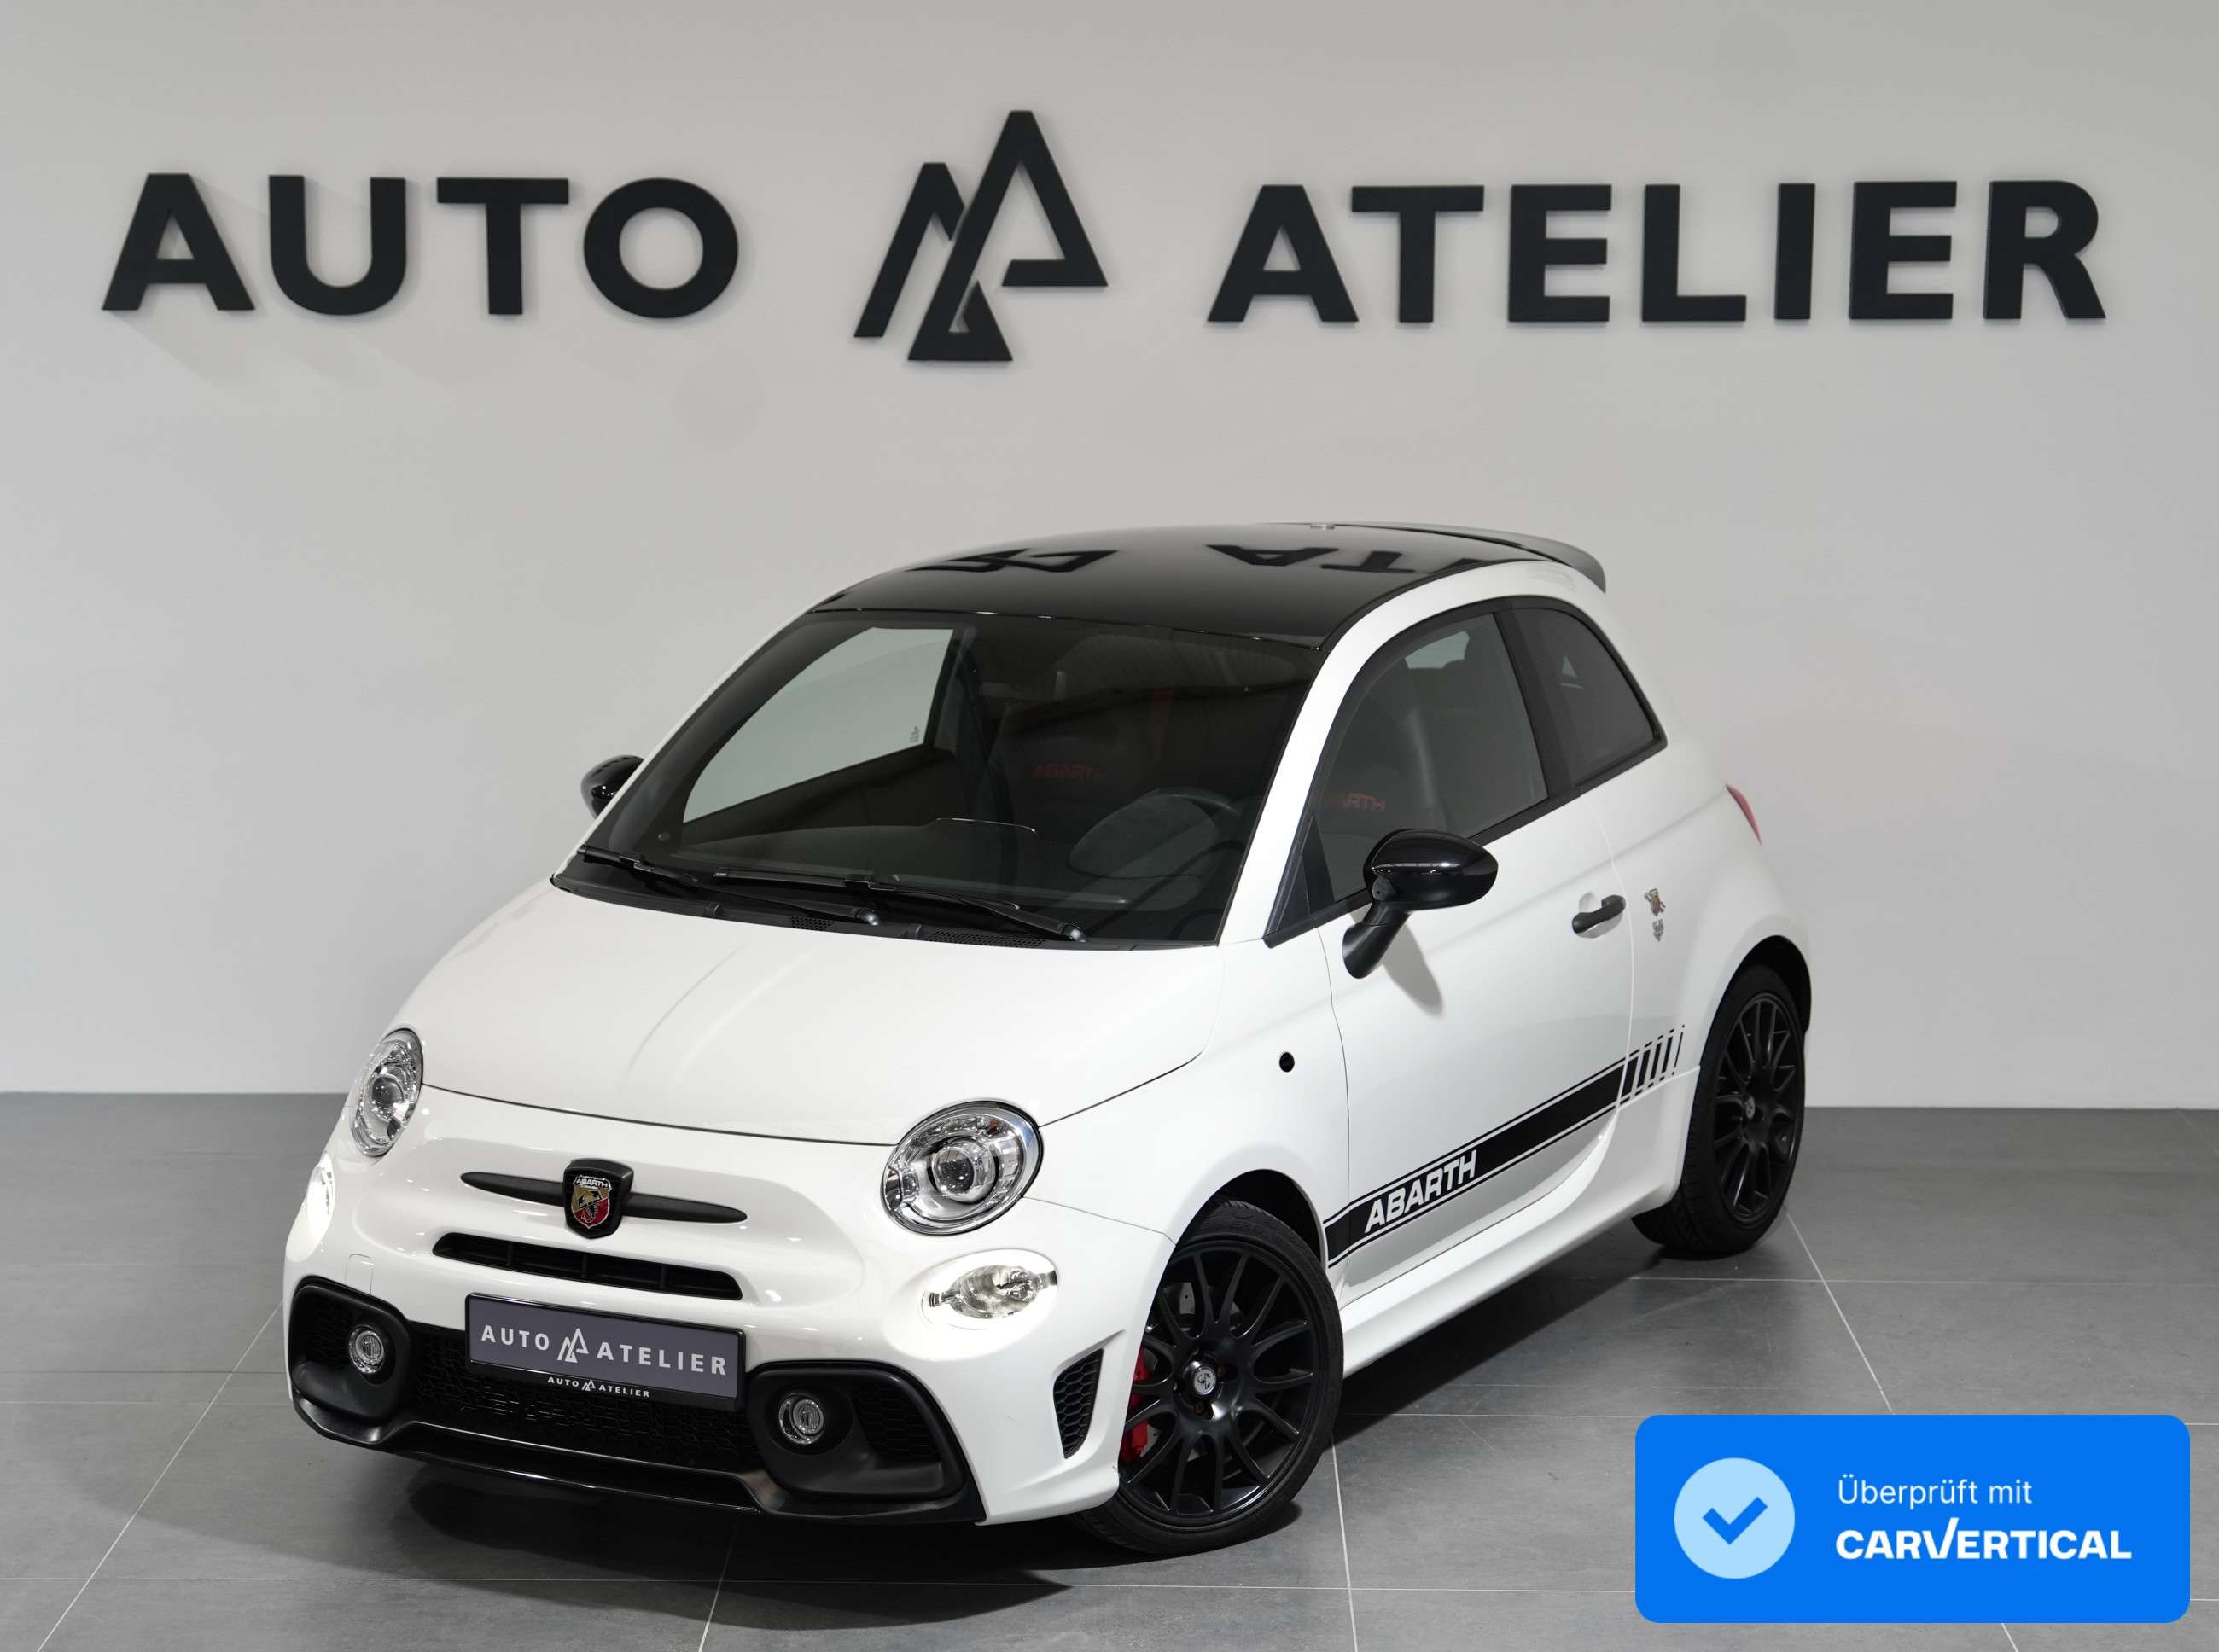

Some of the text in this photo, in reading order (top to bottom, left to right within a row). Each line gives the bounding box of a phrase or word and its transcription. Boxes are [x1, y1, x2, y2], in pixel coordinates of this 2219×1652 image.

[102, 173, 2106, 323] AUTO ATELIER
[576, 1178, 608, 1187] ABARTH
[1365, 1149, 1477, 1233] ABARTH
[480, 1324, 726, 1376] AUTO ATELIER
[547, 1376, 649, 1398] AUTO ATELIER
